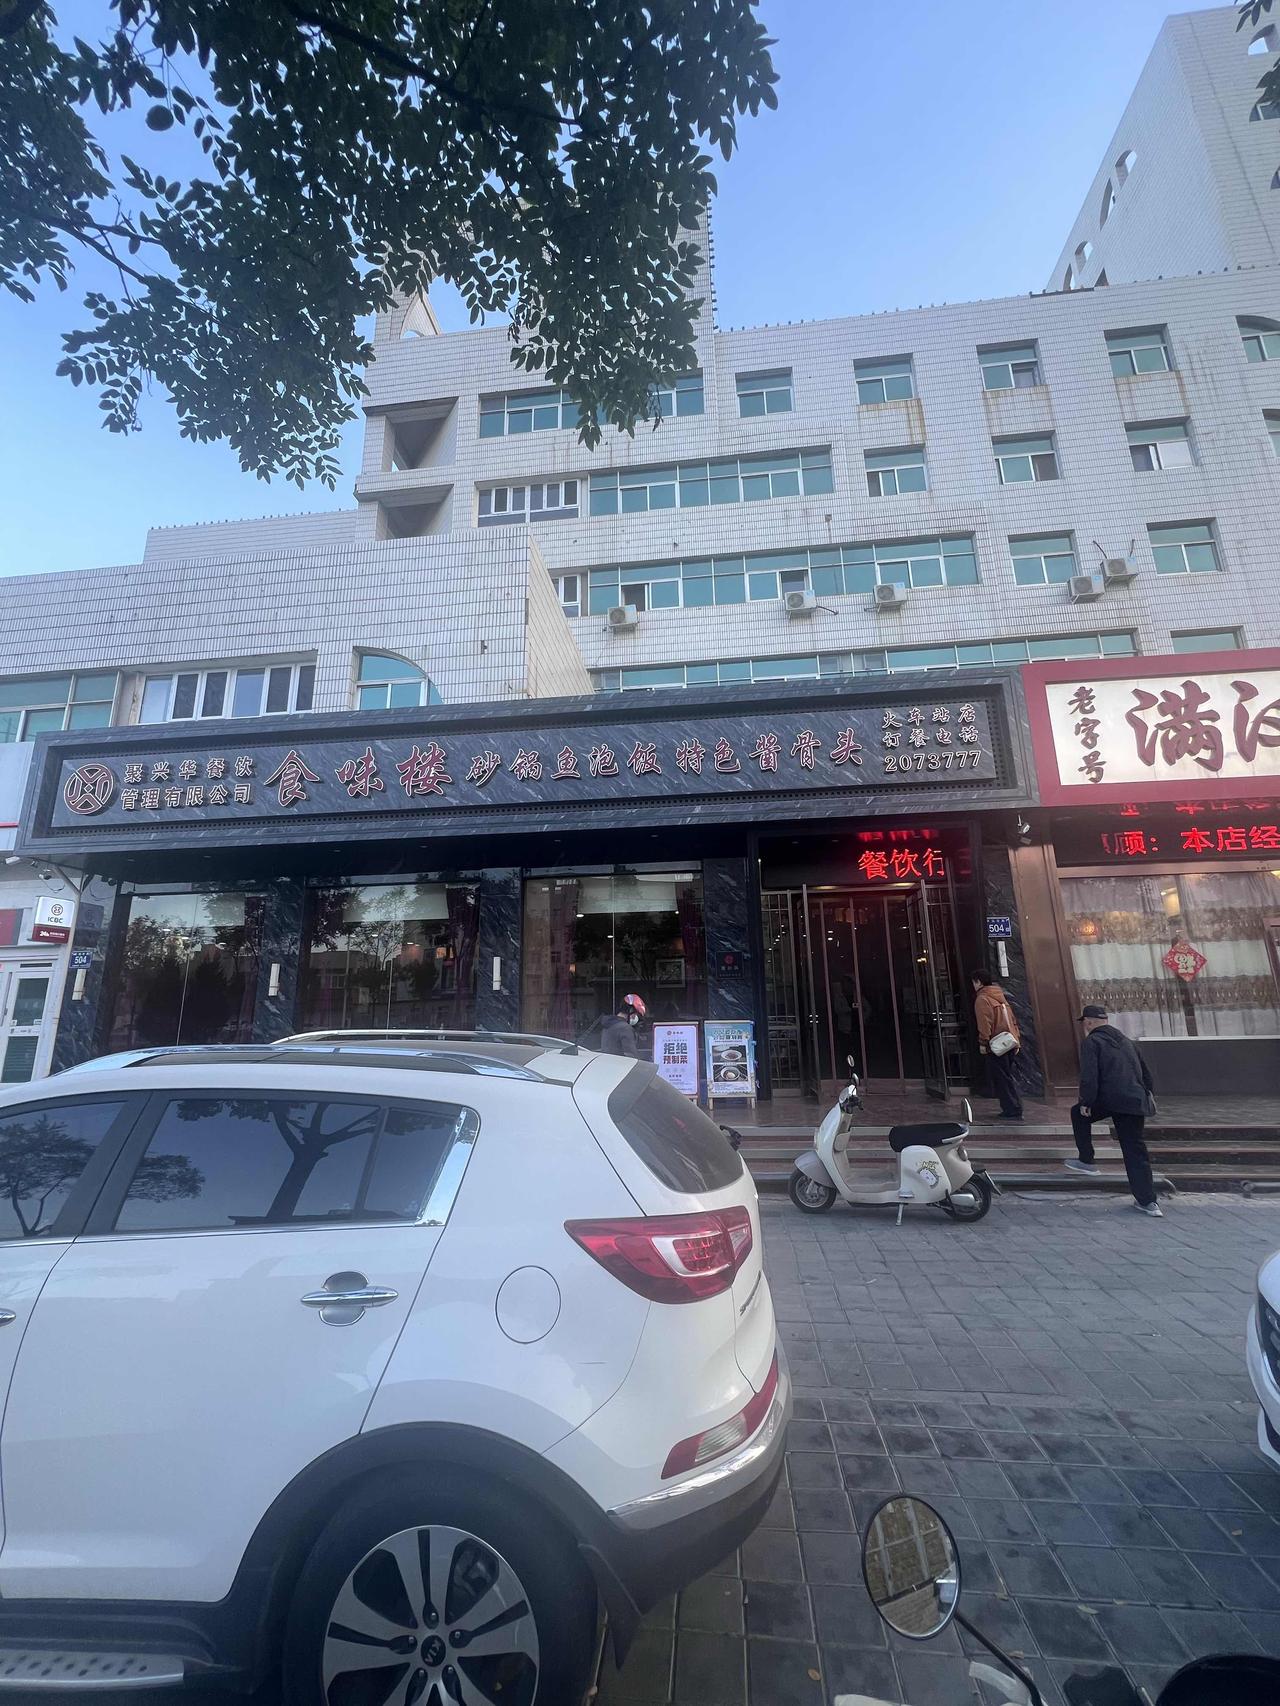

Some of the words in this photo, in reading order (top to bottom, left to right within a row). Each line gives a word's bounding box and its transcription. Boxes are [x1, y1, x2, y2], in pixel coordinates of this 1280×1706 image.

[882, 703, 976, 729] 火车站店
[882, 726, 979, 748] 订餐电话
[1067, 686, 1106, 783] 老字号
[123, 756, 254, 784] 聚兴华餐饮
[264, 741, 453, 806] 食味楼
[466, 741, 662, 787] 砂锅鱼泡饭
[675, 727, 864, 775] 特色酱骨头
[884, 750, 981, 772] 2073777
[120, 783, 252, 811] 管理有限公司
[988, 924, 1004, 933] 504
[75, 956, 86, 964] 504
[663, 1042, 688, 1055] 拒绝
[663, 1055, 688, 1065] 预制菜
